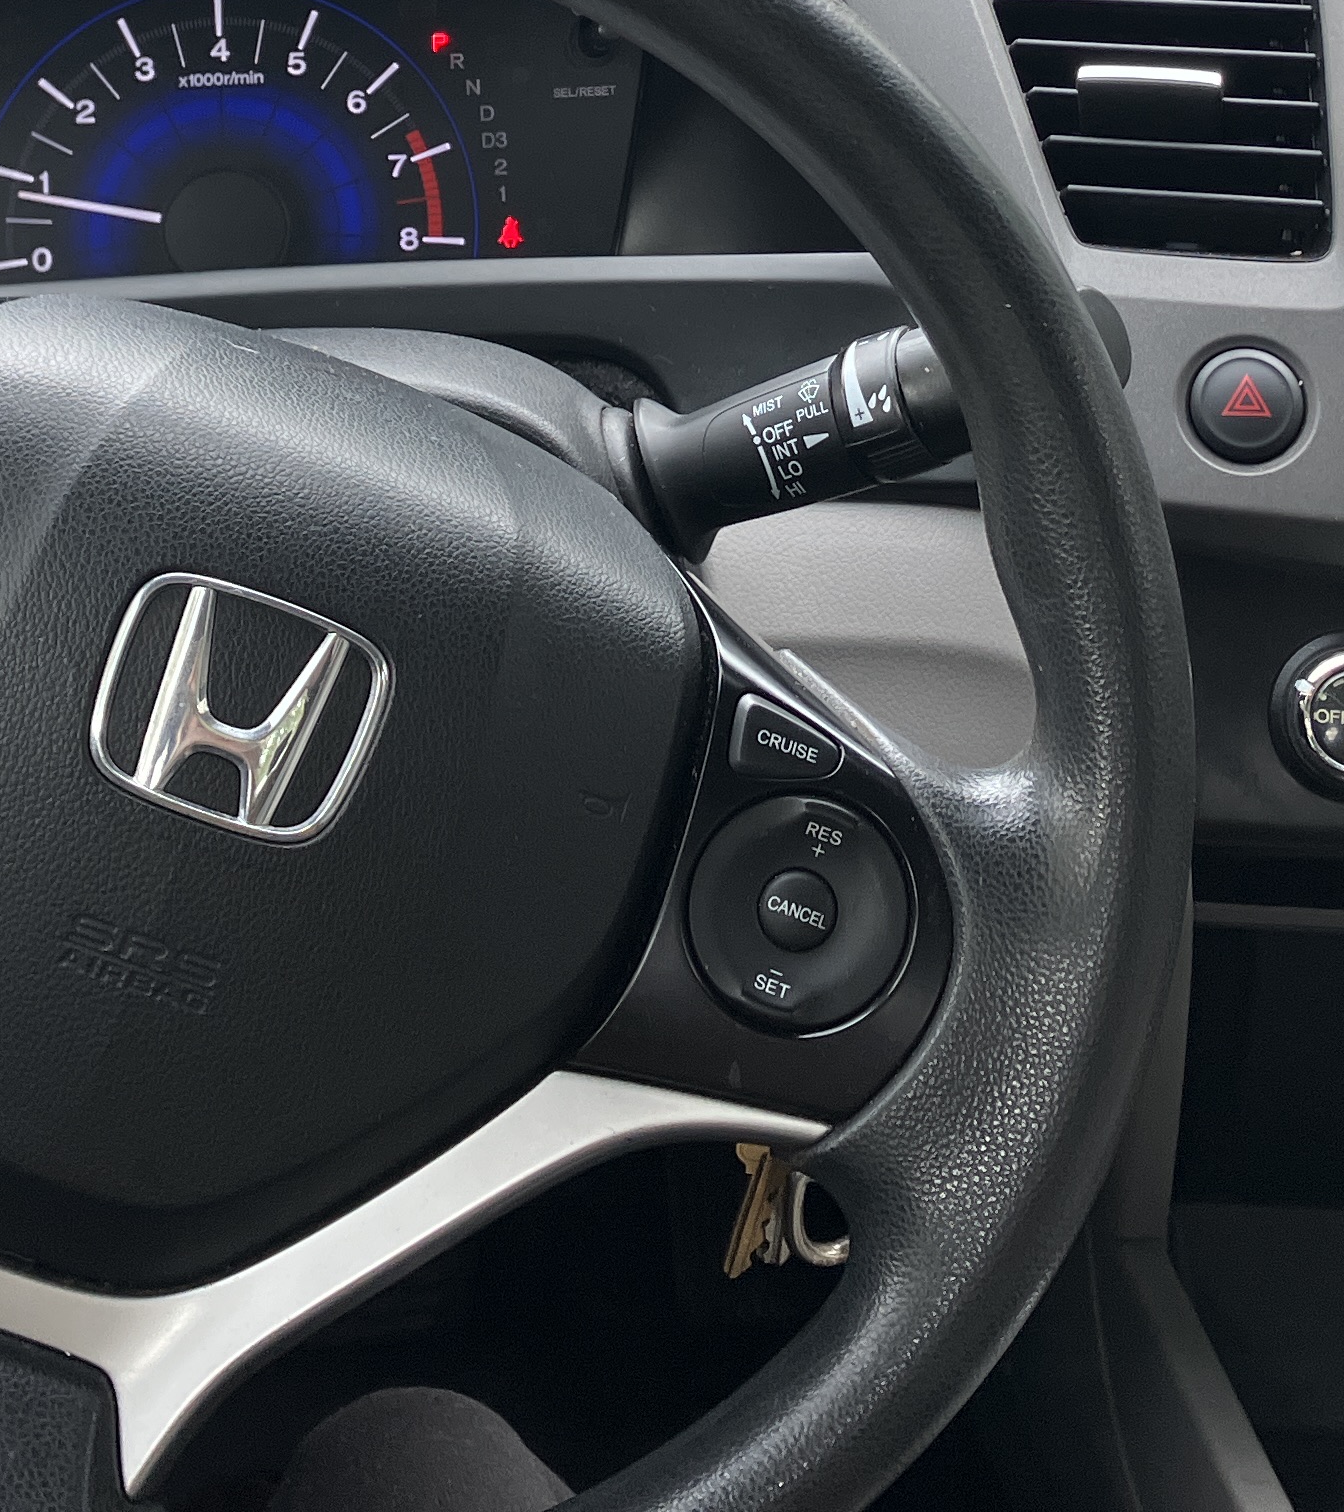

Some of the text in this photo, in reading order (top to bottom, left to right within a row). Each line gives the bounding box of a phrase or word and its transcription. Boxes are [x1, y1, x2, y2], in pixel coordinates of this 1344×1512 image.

[210, 37, 230, 63] 4
[431, 31, 451, 53] P
[134, 55, 155, 83] 3
[287, 50, 307, 76] 5
[449, 53, 465, 70] R
[178, 70, 265, 89] x1000r/min
[465, 79, 481, 96] N
[346, 89, 367, 115] 6
[552, 85, 617, 100] SEL/RESET
[75, 98, 96, 124] 2
[480, 105, 495, 122] D
[482, 131, 508, 149] D3
[387, 153, 408, 178] 7
[494, 159, 508, 176] 2
[38, 170, 50, 195] 1
[498, 185, 507, 202] 1
[399, 227, 420, 251] 8
[31, 246, 53, 273] 0
[752, 395, 784, 417] MIST
[796, 402, 829, 423] PULL
[762, 419, 794, 444] OFF
[772, 439, 798, 460] INT
[778, 460, 803, 479] LO
[785, 482, 806, 497] HI
[756, 728, 819, 765] CRUISE
[805, 821, 843, 846] RES
[766, 894, 827, 931] CANCEL
[753, 973, 792, 1000] SET
